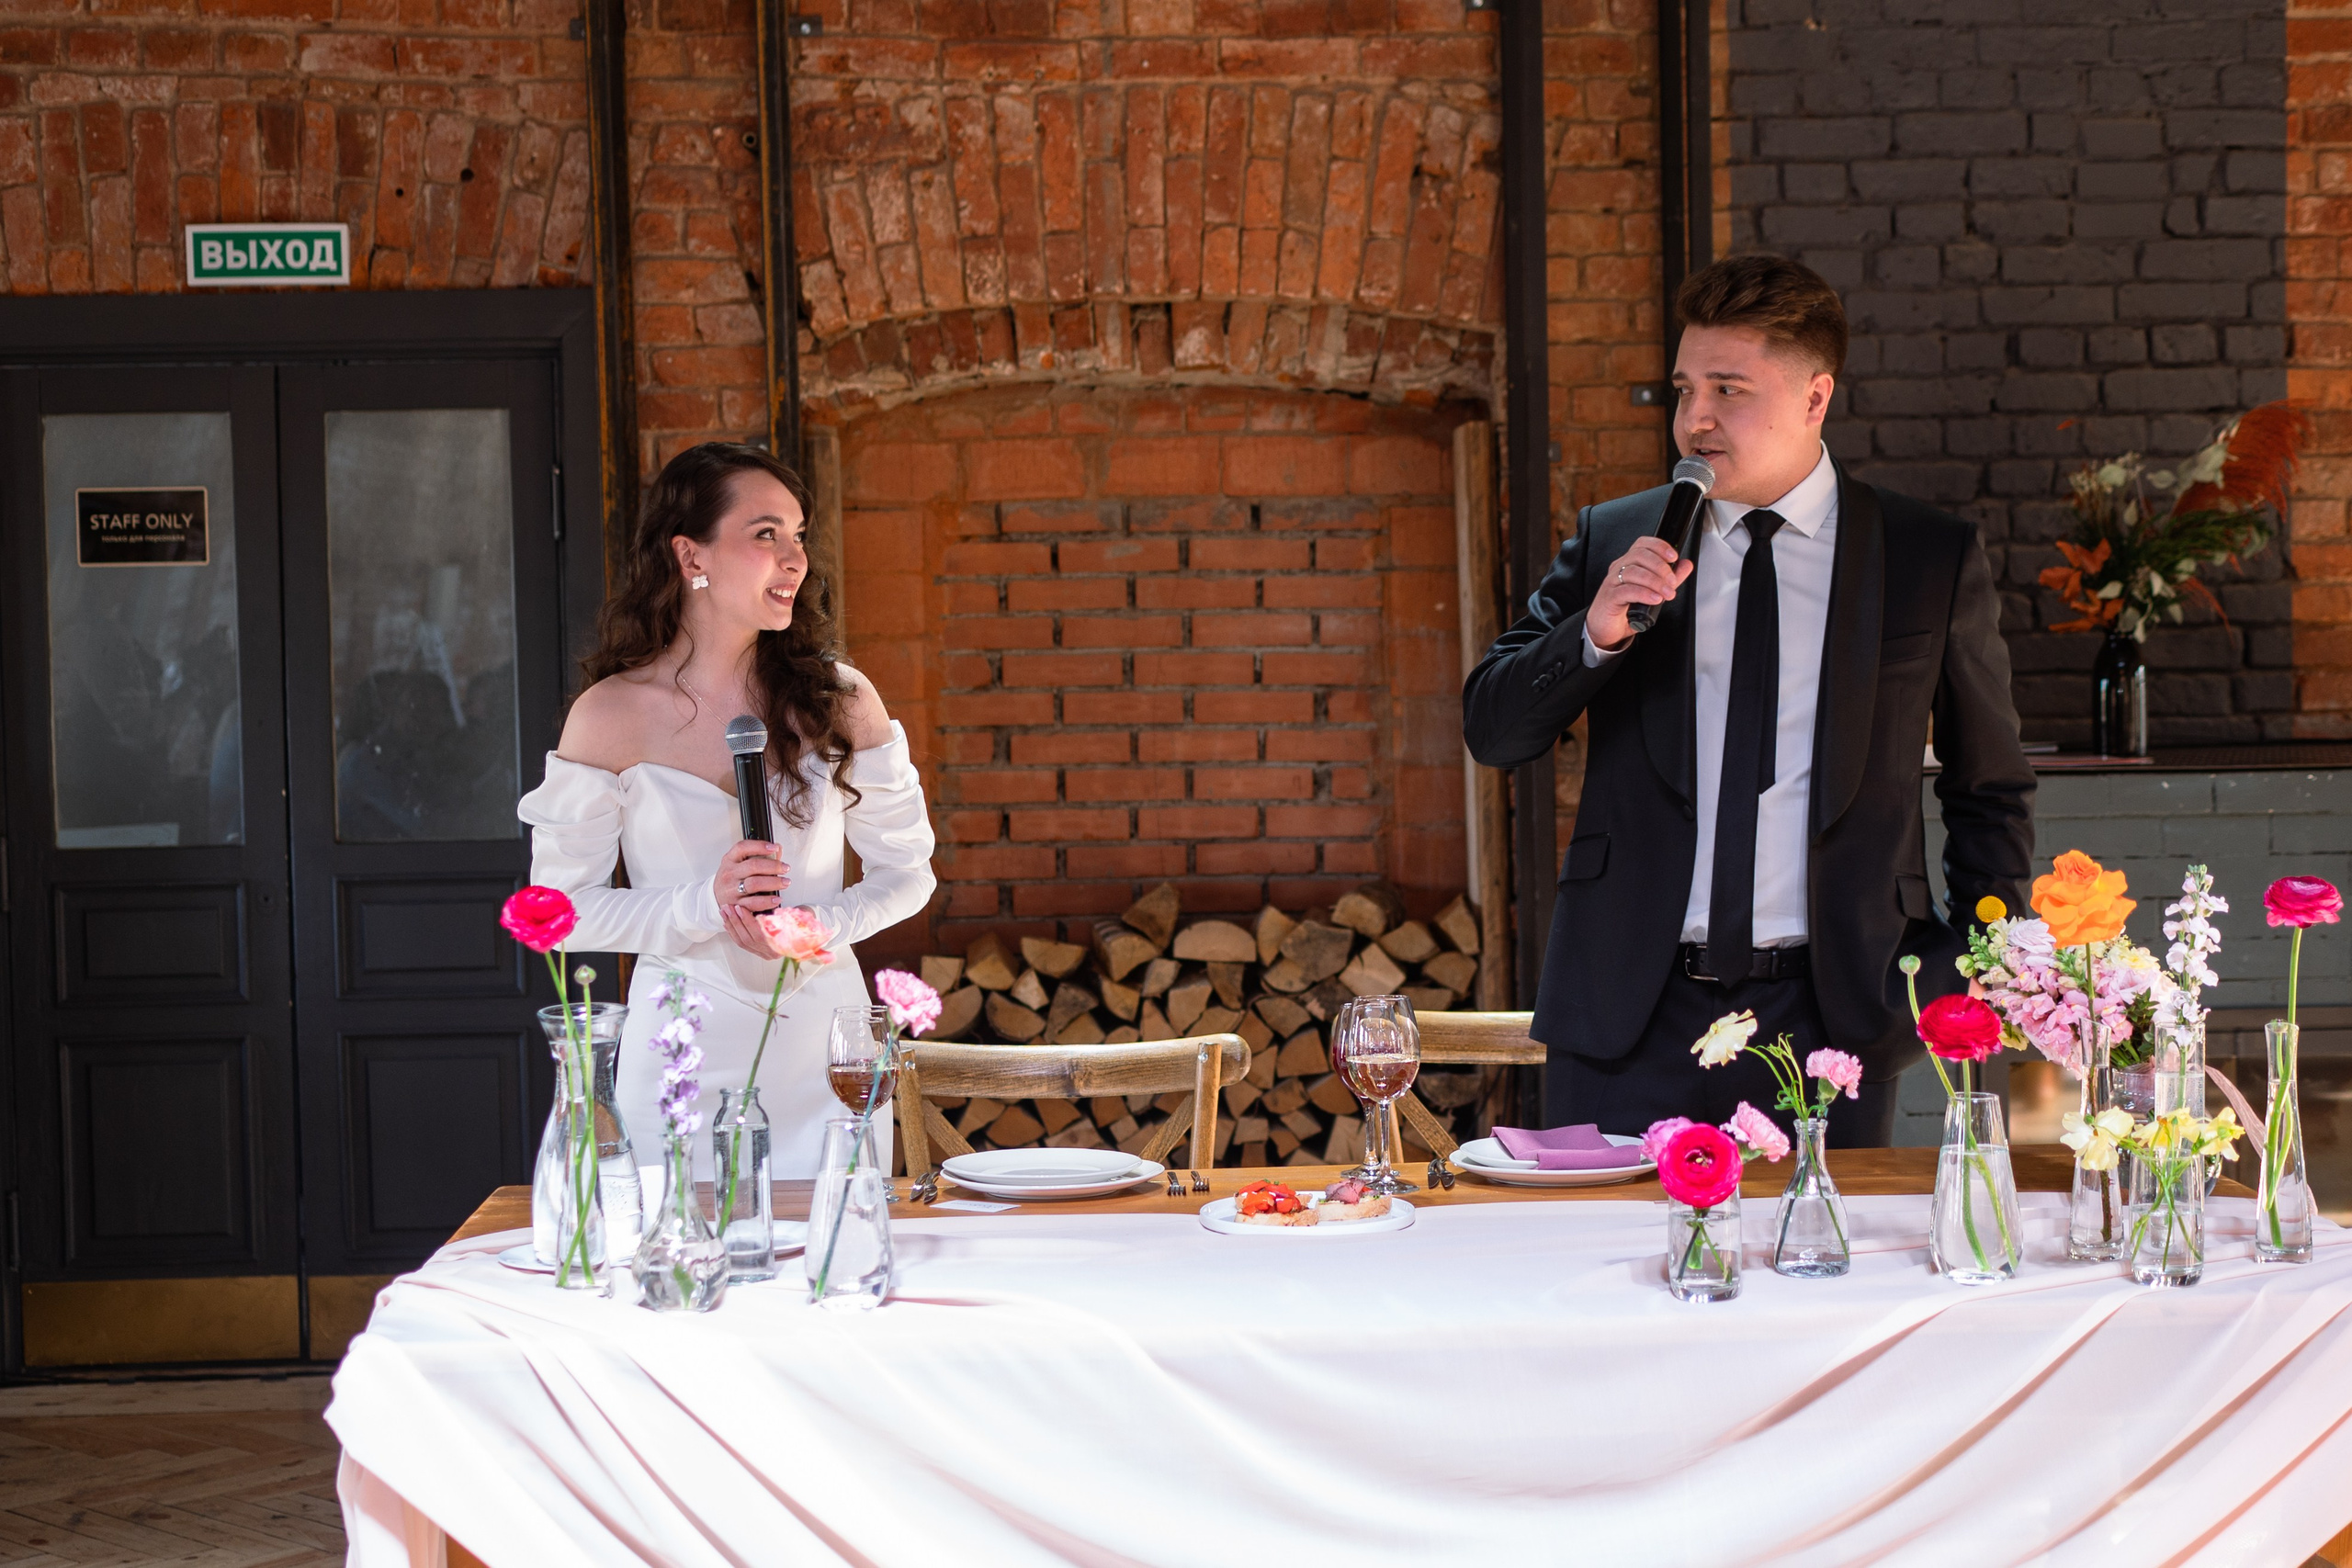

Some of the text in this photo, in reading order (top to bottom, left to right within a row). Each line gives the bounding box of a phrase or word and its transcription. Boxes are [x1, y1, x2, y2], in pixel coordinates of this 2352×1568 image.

[200, 239, 338, 272] ВЫХОД
[89, 513, 194, 530] STAFF ONLY
